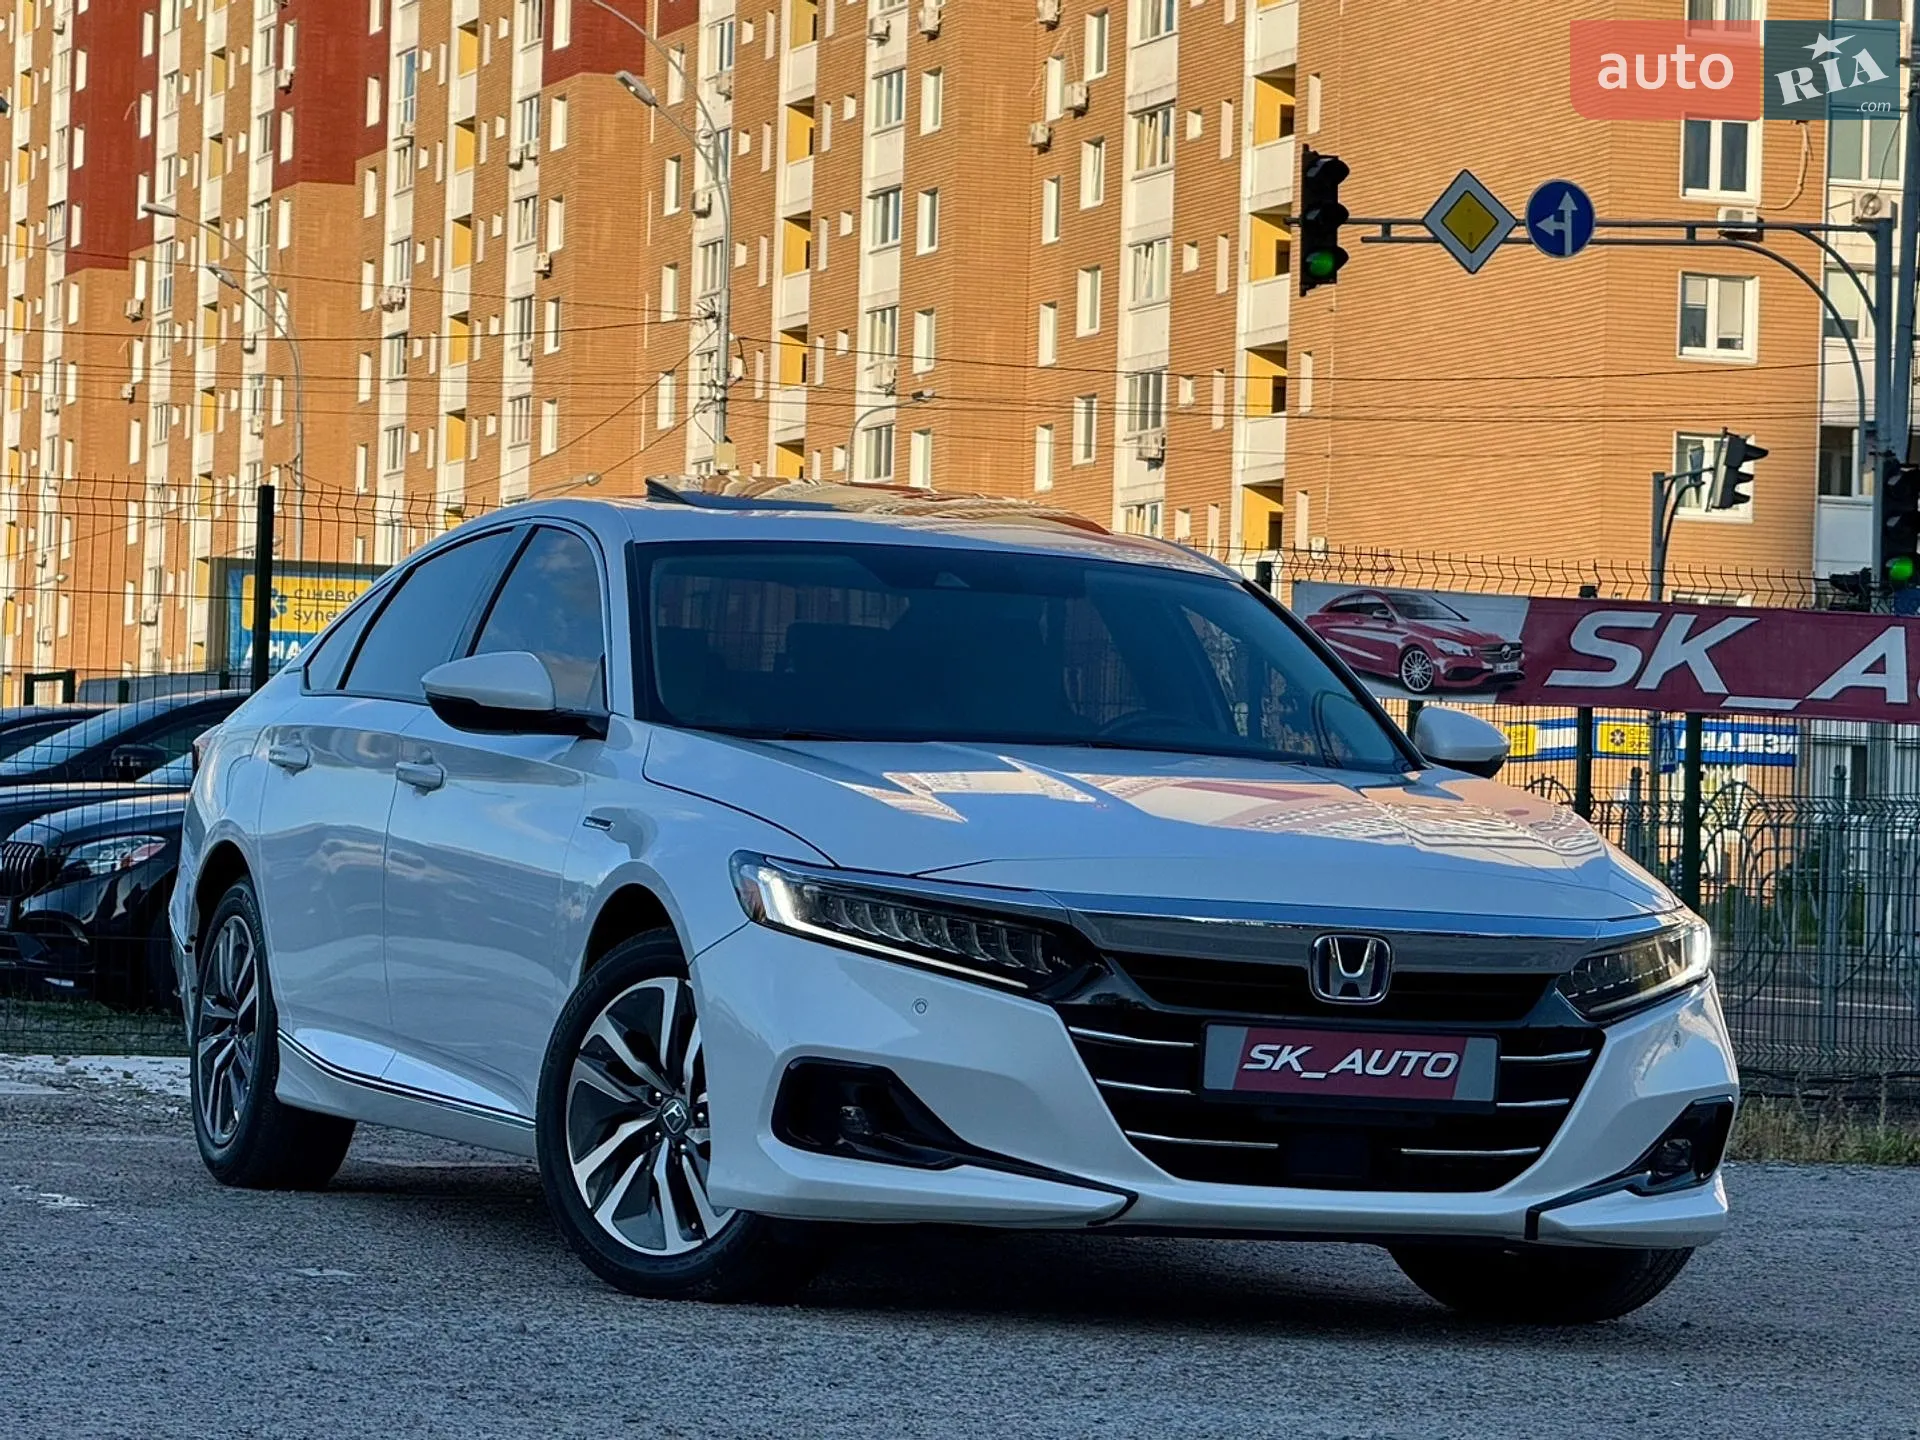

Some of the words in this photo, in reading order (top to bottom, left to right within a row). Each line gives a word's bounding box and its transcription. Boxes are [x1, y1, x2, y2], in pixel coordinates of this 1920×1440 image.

[293, 609, 338, 626] syne
[1543, 610, 1920, 710] SK_A
[1242, 1044, 1459, 1079] SK_AUTO
